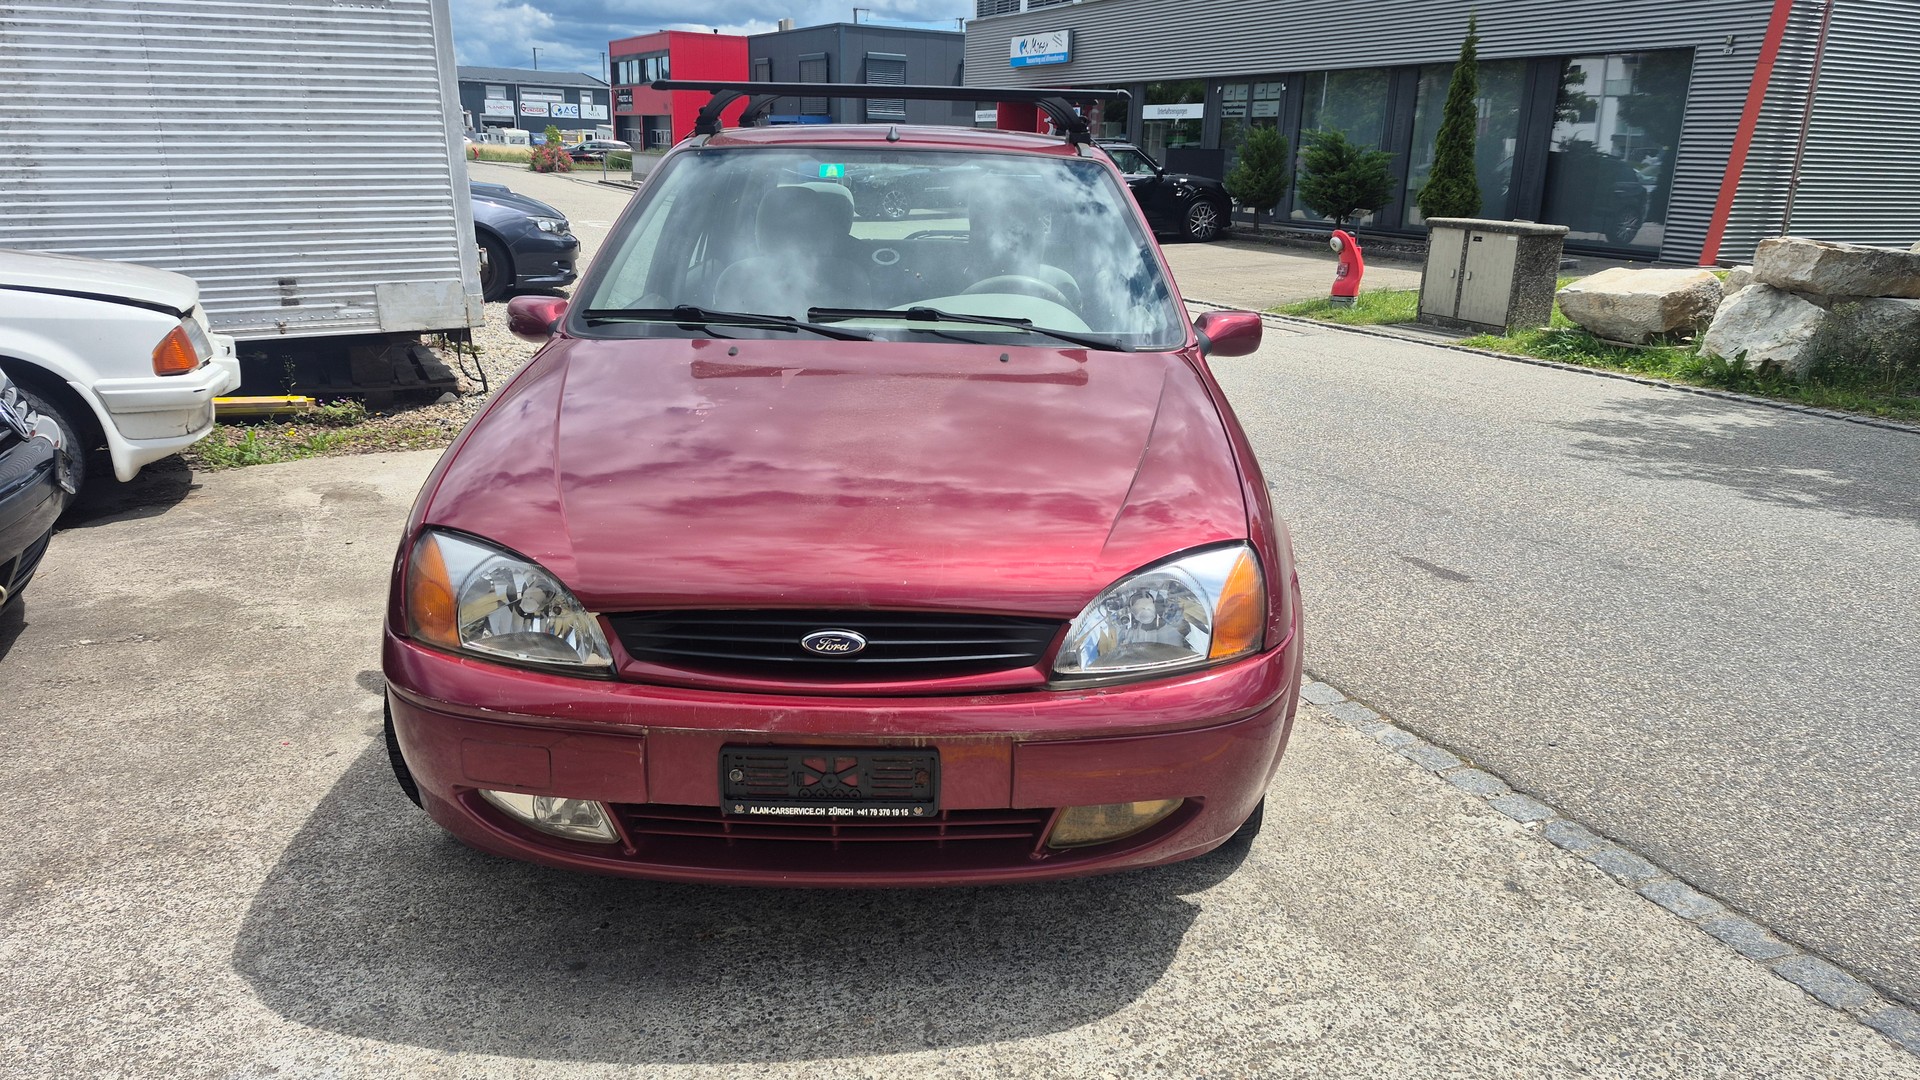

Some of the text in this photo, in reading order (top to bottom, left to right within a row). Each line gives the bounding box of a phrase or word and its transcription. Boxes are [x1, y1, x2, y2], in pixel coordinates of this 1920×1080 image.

[815, 638, 850, 651] Ford
[750, 806, 909, 816] ALAN-CARSERVICE.CH ZÜRICH +41 79 370 19 15
